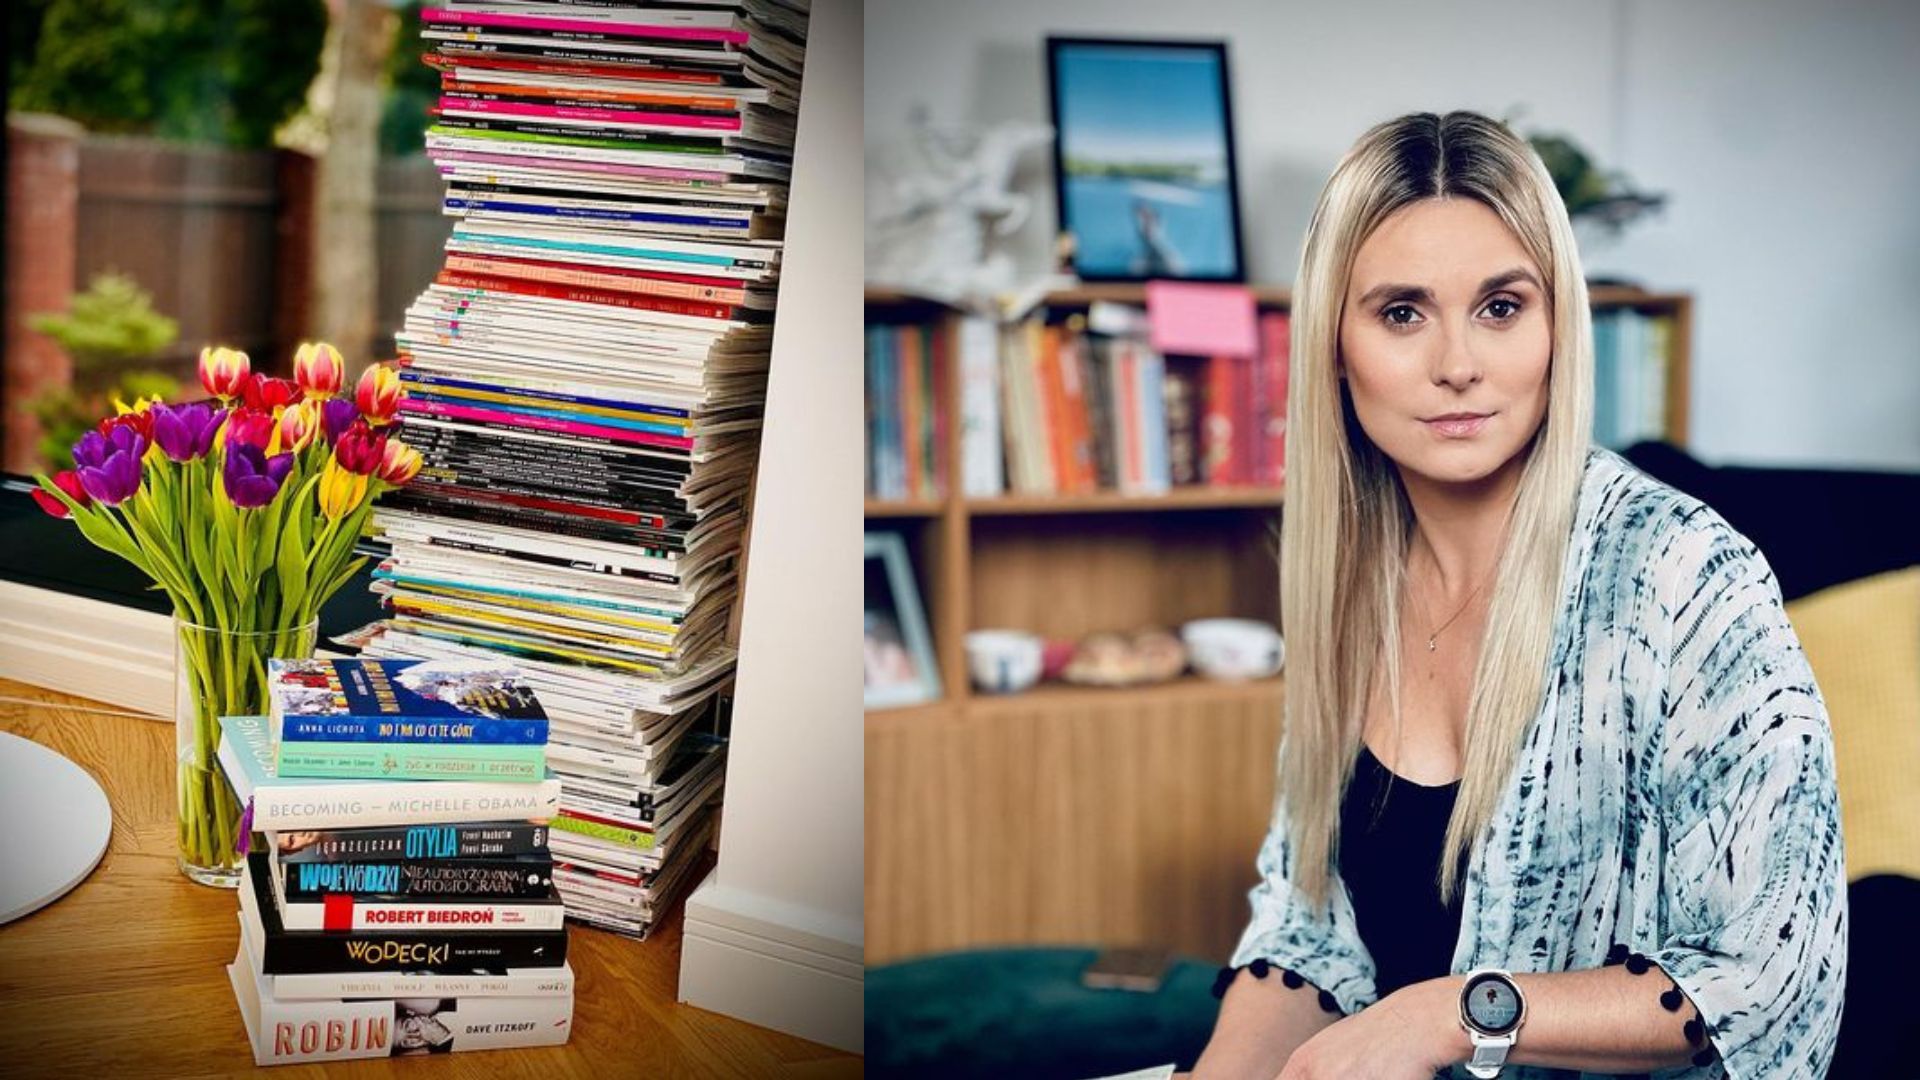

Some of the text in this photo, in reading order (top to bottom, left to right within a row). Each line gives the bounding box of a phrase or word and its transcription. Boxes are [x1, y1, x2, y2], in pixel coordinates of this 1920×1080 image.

[299, 724, 365, 734] ANNA LICHOTA
[379, 722, 475, 738] NO I NA CO CI TE GÓRY
[270, 802, 362, 817] BECOMING
[388, 799, 471, 812] MICHELLE
[478, 797, 538, 809] OBAMA
[406, 826, 457, 859] OTYLIA
[300, 864, 400, 892] WOJEWÓDZKI
[400, 864, 520, 881] NIEAUTORYZOWANA
[404, 879, 515, 894] AUTOBIOGRAFIA
[365, 911, 424, 924] ROBERT
[427, 907, 494, 923] BIEDROŃ
[346, 940, 449, 965] WODECKI
[275, 1016, 388, 1056] ROBIN
[466, 1022, 536, 1034] DAVE ITZKOFF
